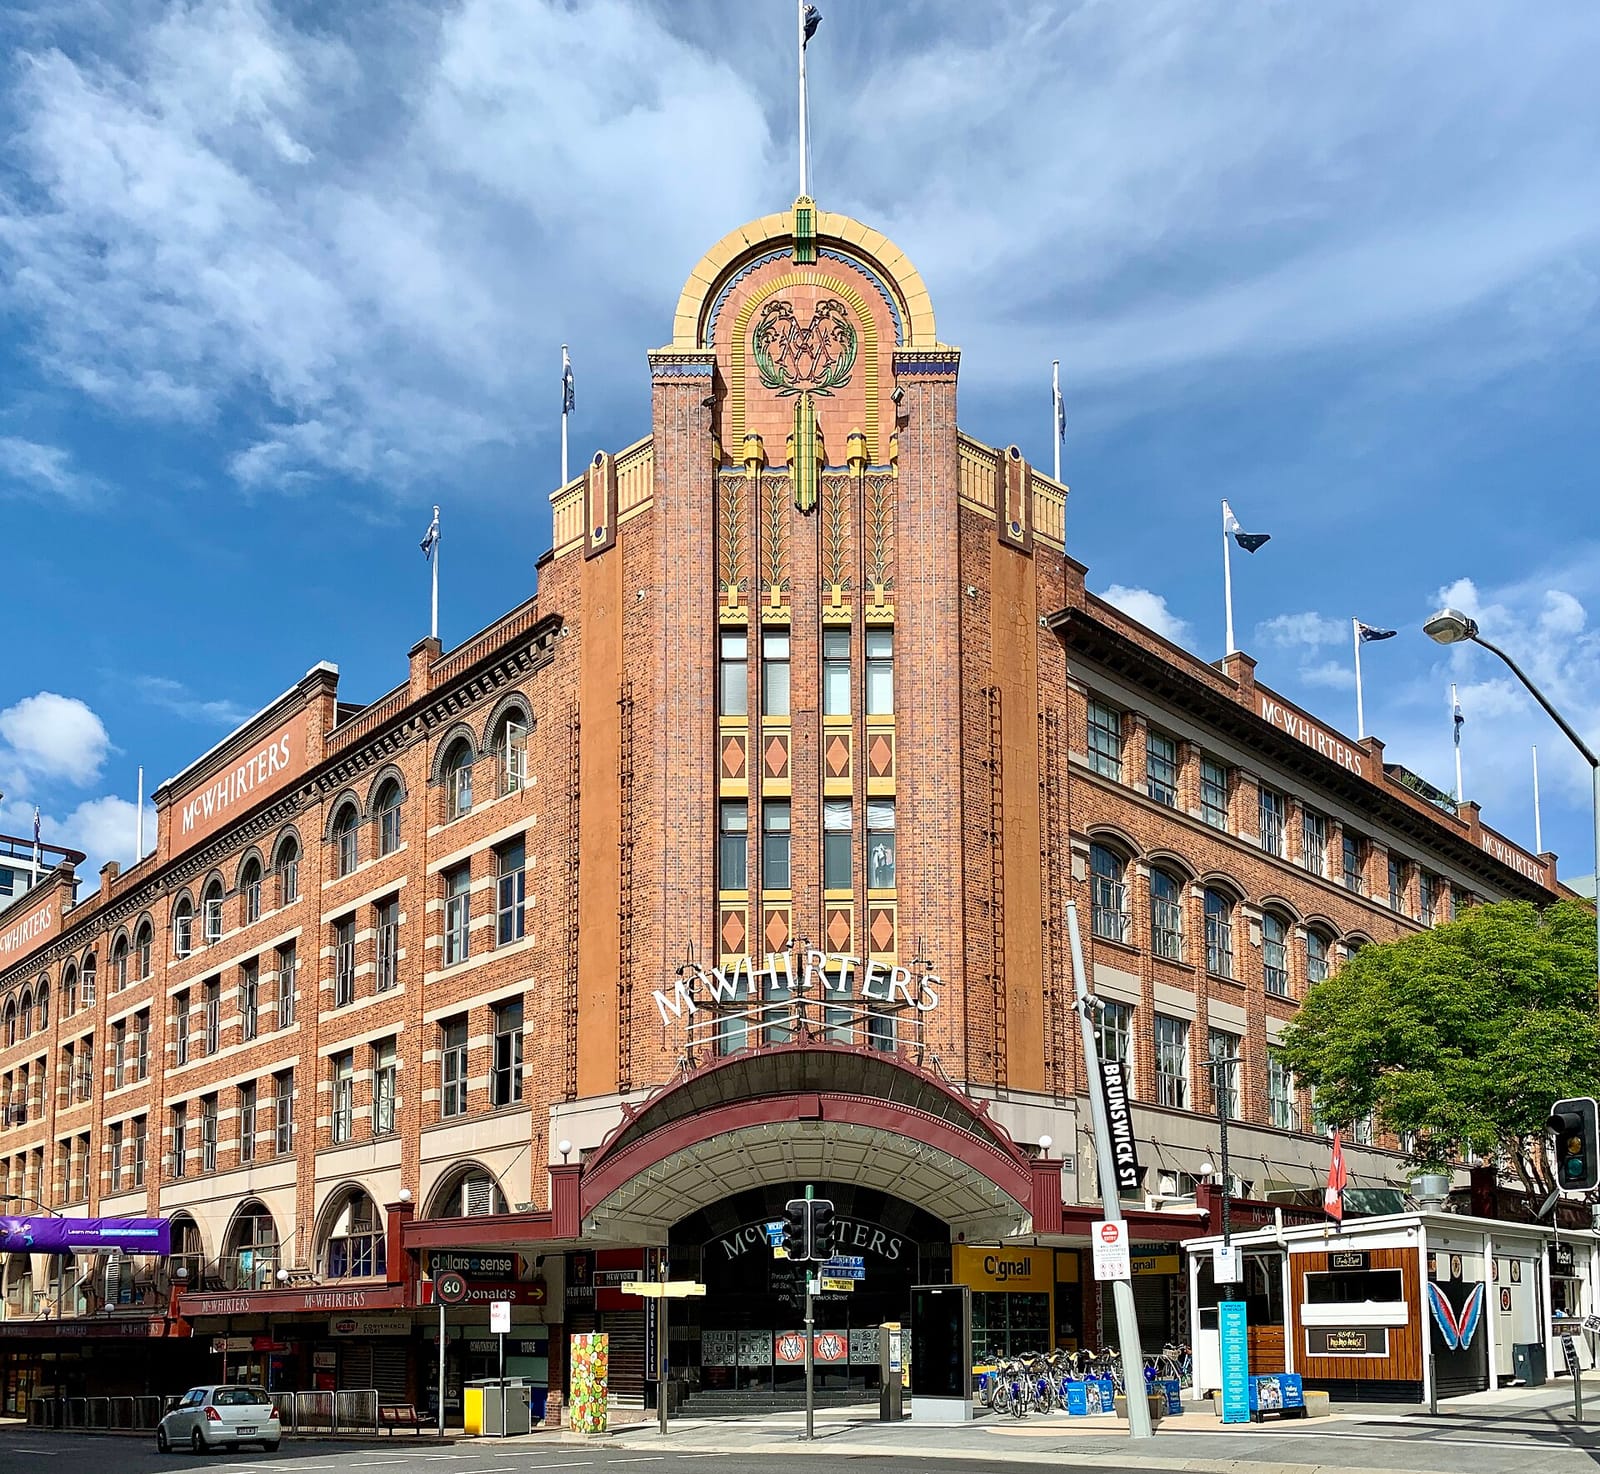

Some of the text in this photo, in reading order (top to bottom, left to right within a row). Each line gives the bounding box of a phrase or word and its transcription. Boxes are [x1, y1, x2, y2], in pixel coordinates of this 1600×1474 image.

[1262, 698, 1362, 776] McWHIRTERS
[181, 733, 290, 835] McWHIRTERS
[1103, 1063, 1138, 1187] BRUNSWICK ST
[479, 1258, 512, 1271] sense
[983, 1255, 1031, 1281] Cignall
[1132, 1259, 1156, 1273] gnall
[443, 1281, 460, 1293] 60
